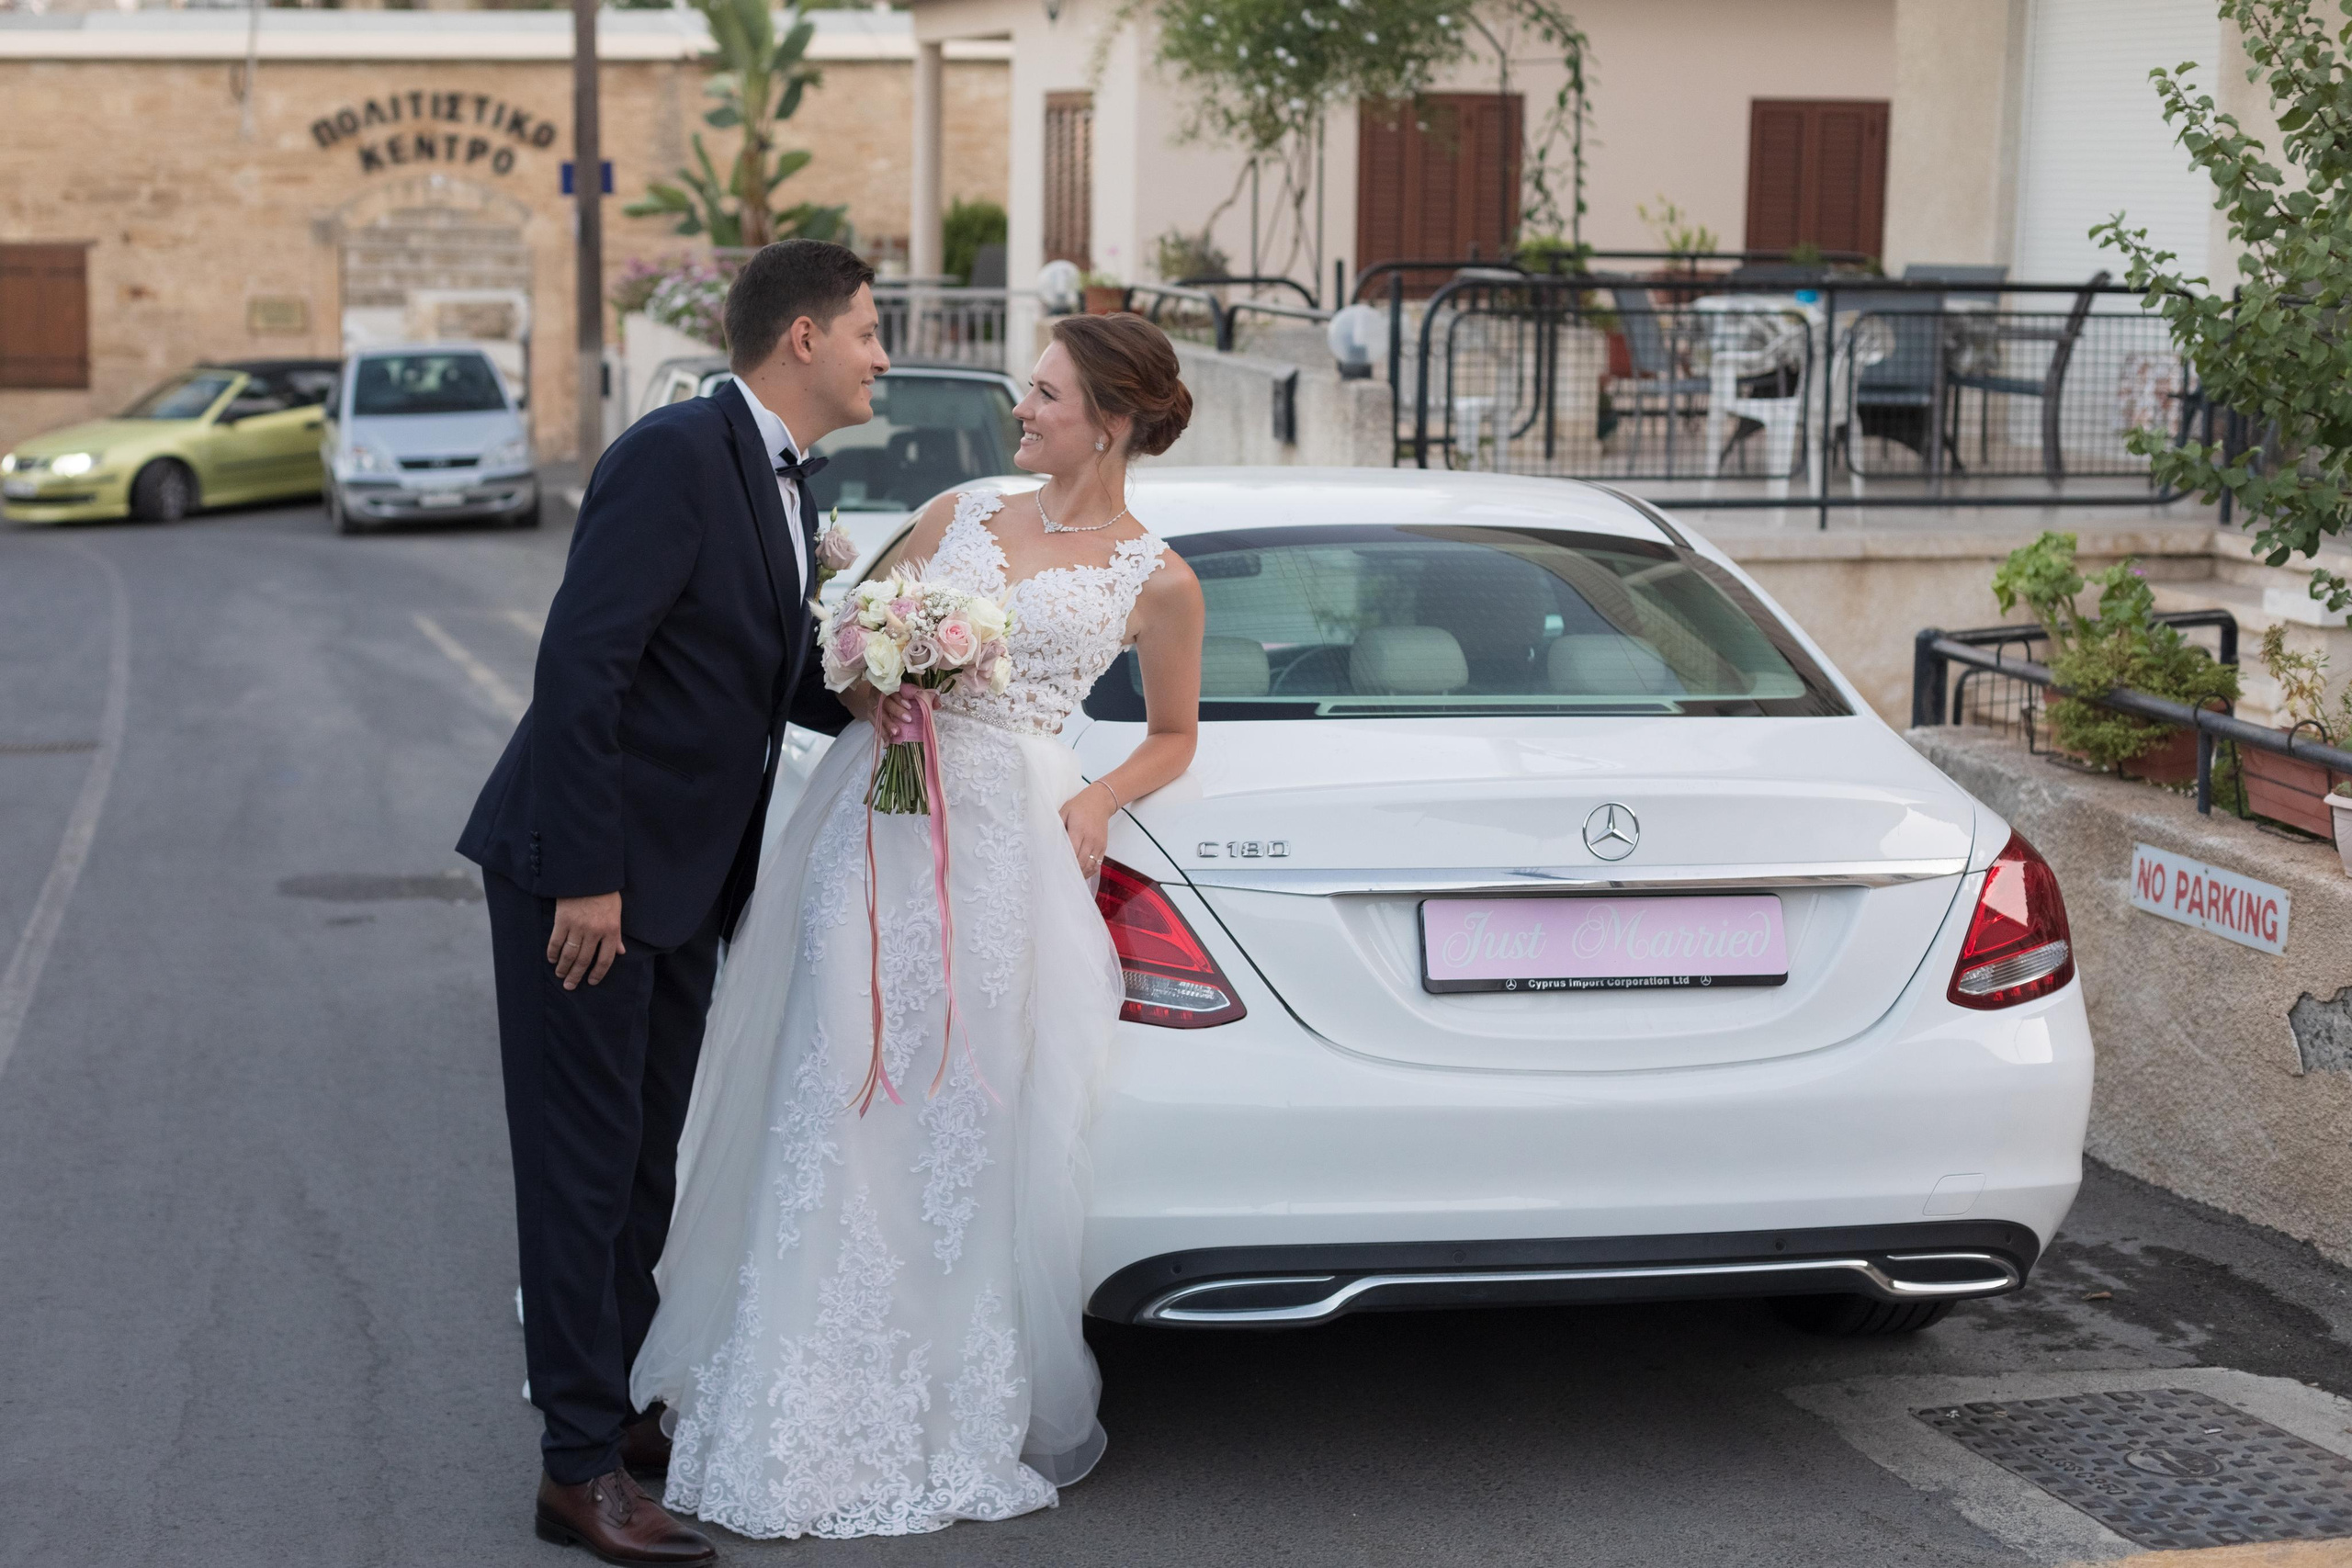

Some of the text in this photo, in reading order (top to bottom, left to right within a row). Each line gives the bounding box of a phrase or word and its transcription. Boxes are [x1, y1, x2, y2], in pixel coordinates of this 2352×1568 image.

[311, 90, 557, 150] ΠΟΛΙΤΙΣΤΙΚΟ
[357, 134, 516, 175] ΚΕΝΤΡΟ
[2137, 857, 2278, 944] NO PARKING
[1442, 903, 1771, 968] Just Married
[1528, 976, 1690, 989] Cyprus Import Corporation Ltd
